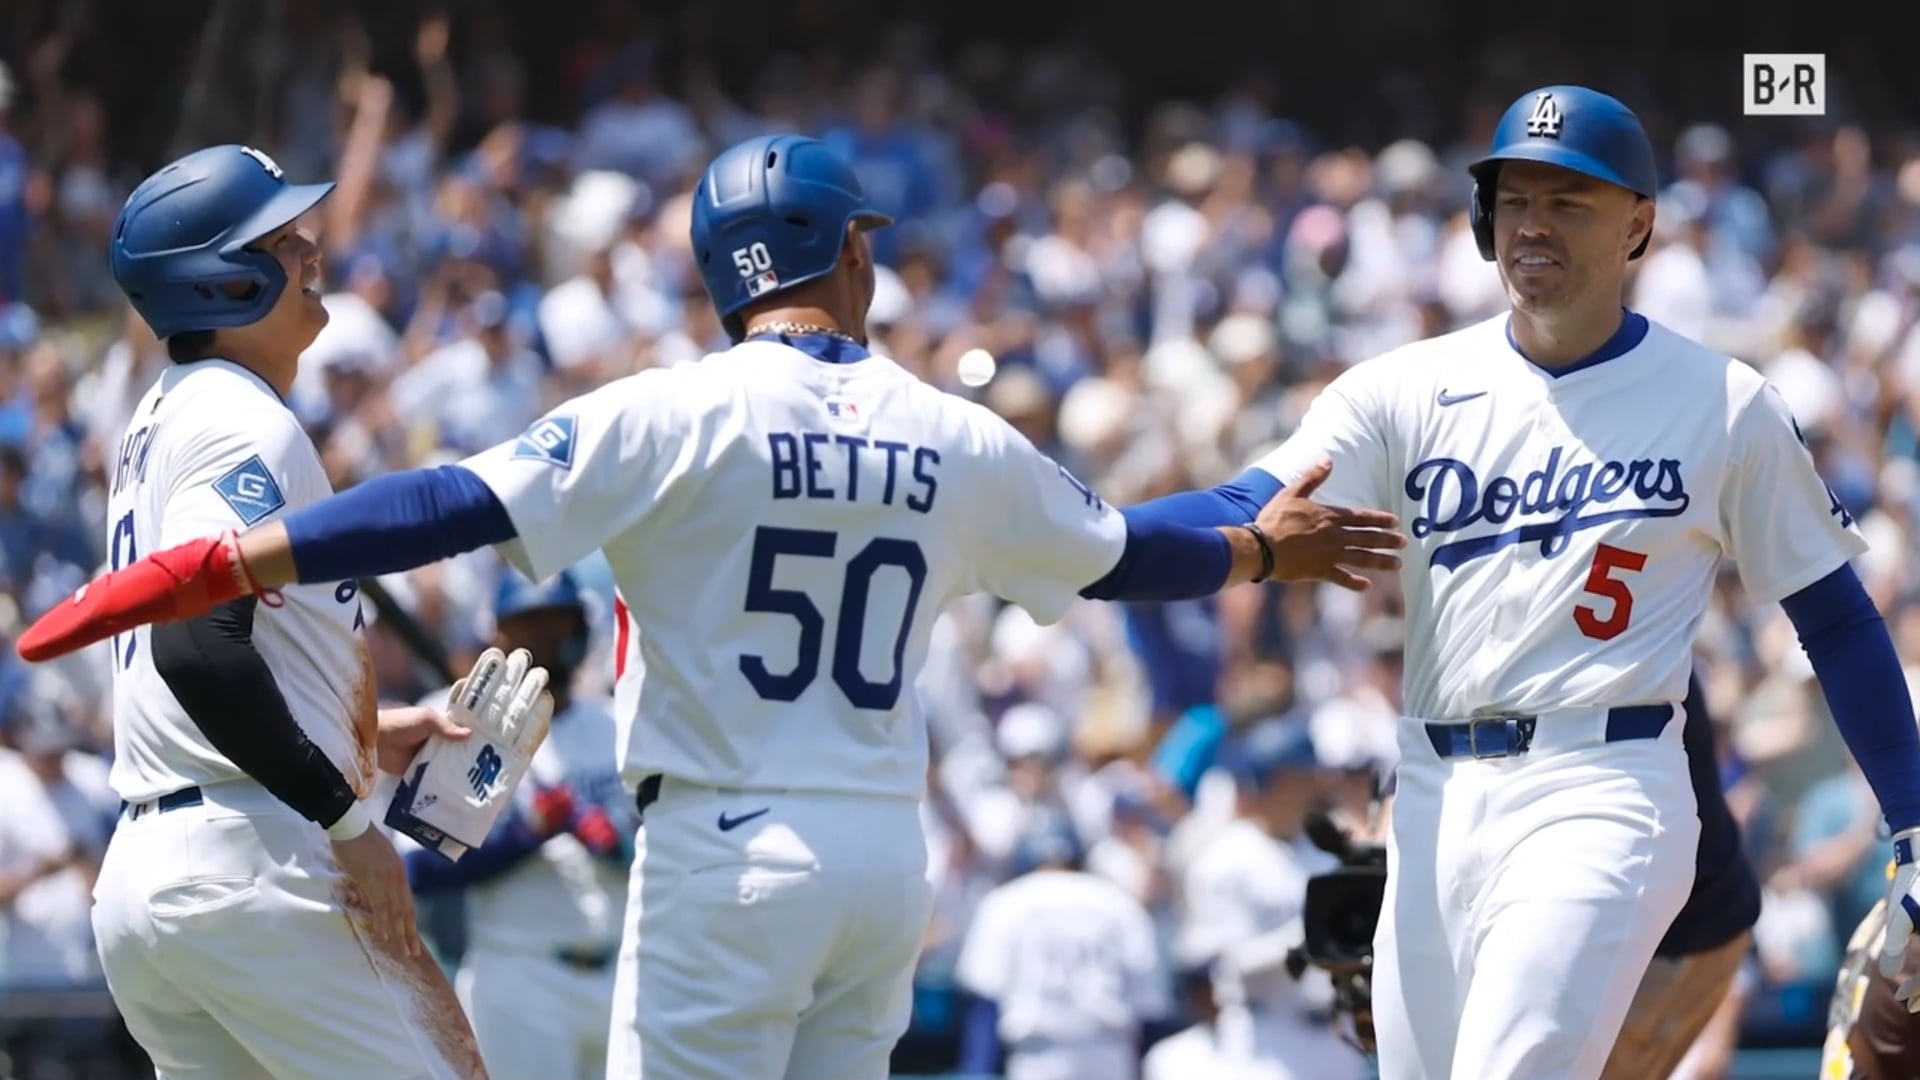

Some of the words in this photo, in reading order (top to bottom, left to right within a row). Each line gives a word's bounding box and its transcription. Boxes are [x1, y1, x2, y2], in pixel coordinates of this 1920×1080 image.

[1527, 92, 1561, 138] LA
[732, 242, 772, 278] 50
[238, 473, 266, 498] G
[768, 432, 941, 515] BETTS
[1405, 446, 1690, 562] Dodgers
[738, 525, 928, 711] 50
[1573, 542, 1648, 641] 5
